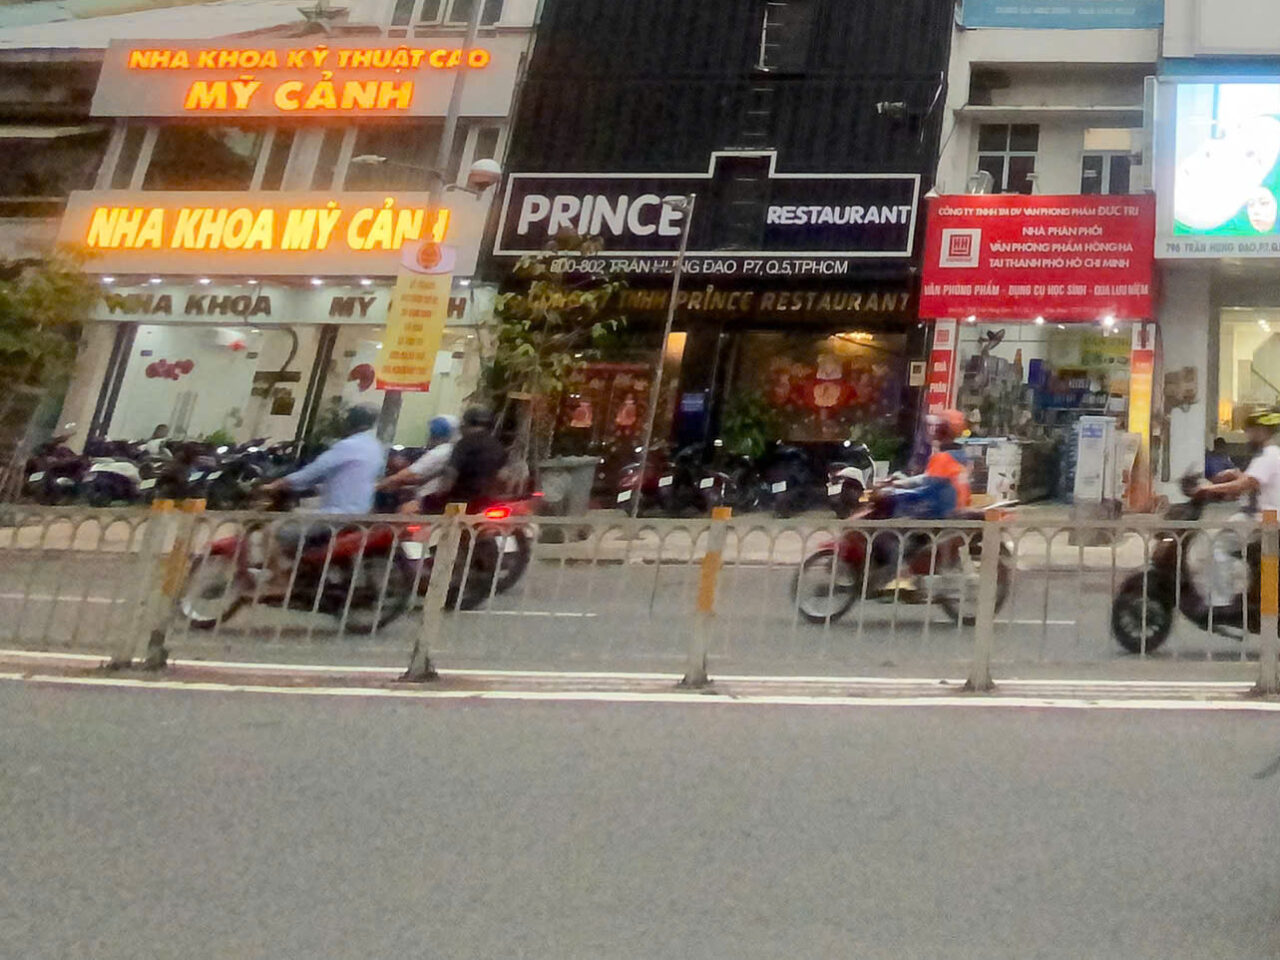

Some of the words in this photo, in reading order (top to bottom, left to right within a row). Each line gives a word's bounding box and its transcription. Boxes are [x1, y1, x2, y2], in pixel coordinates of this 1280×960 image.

[128, 49, 190, 70] NHA
[197, 49, 278, 70] KHOA
[286, 44, 330, 69] KỸ
[337, 44, 426, 72] THUẬT
[184, 74, 262, 111] MỸ
[273, 70, 415, 111] CẢNH
[88, 207, 165, 249] NHA
[171, 207, 274, 250] KHOA
[280, 201, 342, 250] MỸ
[516, 193, 688, 236] PRINCE
[766, 204, 912, 225] RESTAURANT
[550, 259, 606, 274] 800-802
[183, 294, 272, 317] KHOA
